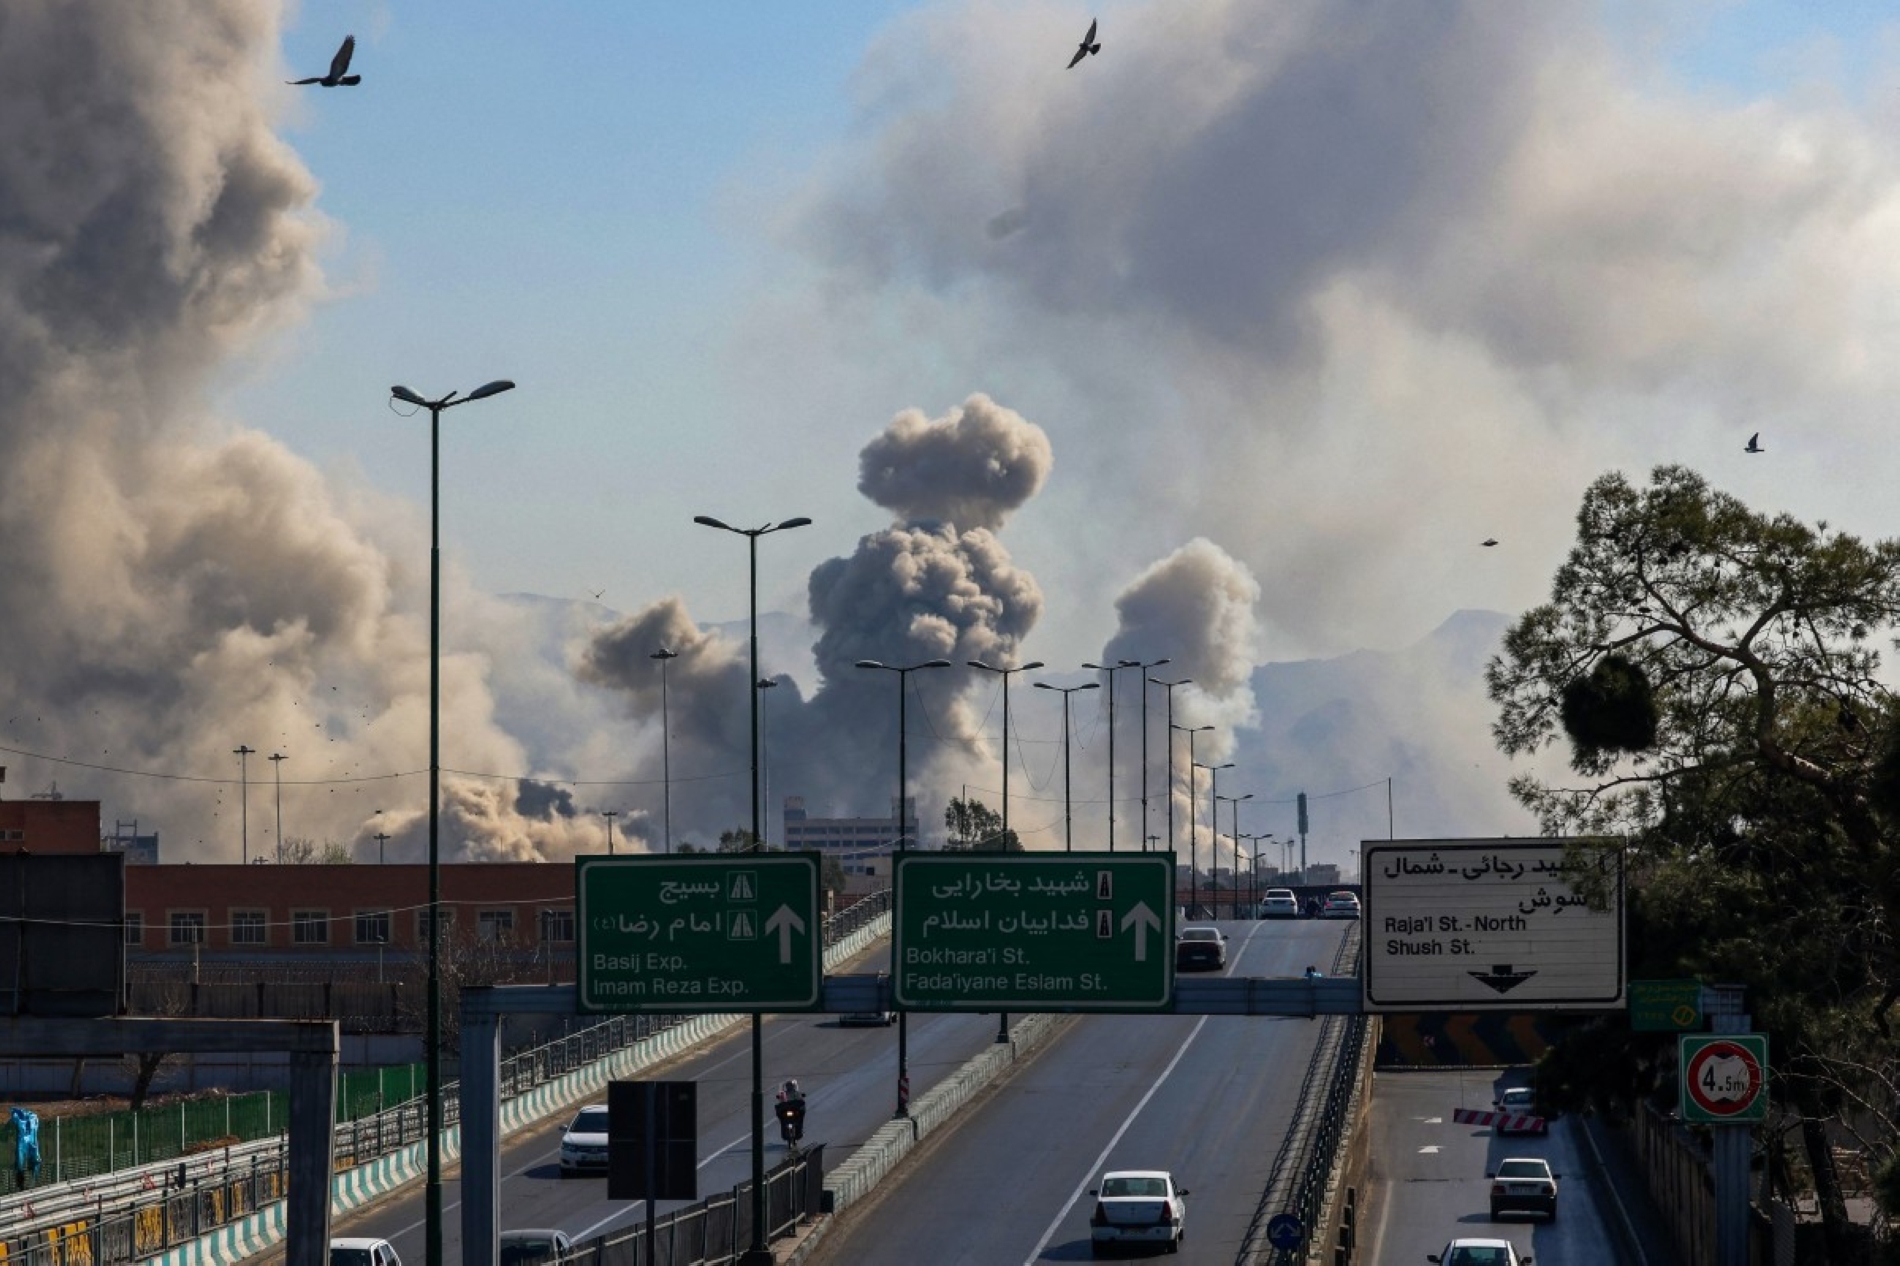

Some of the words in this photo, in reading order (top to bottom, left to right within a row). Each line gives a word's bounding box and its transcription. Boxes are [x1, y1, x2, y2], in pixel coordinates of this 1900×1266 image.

[658, 881, 720, 905] بسیج
[932, 872, 1021, 900] بخارایی
[1028, 870, 1090, 897] شهید
[669, 912, 721, 942] امام
[923, 909, 989, 938] اسلام
[998, 909, 1090, 935] فداییان
[906, 947, 997, 965] Bokhara'i
[1002, 947, 1031, 965] St.
[1386, 939, 1442, 955] Shush
[1450, 938, 1475, 954] St.
[593, 954, 641, 973] Basij
[646, 953, 687, 972] Exp.
[593, 979, 646, 995] Imam
[652, 978, 701, 994] Reza
[708, 977, 749, 996] Exp.
[906, 973, 1008, 993] Fada'iyane
[1014, 973, 1073, 990] Eslam
[1079, 973, 1109, 990] St.
